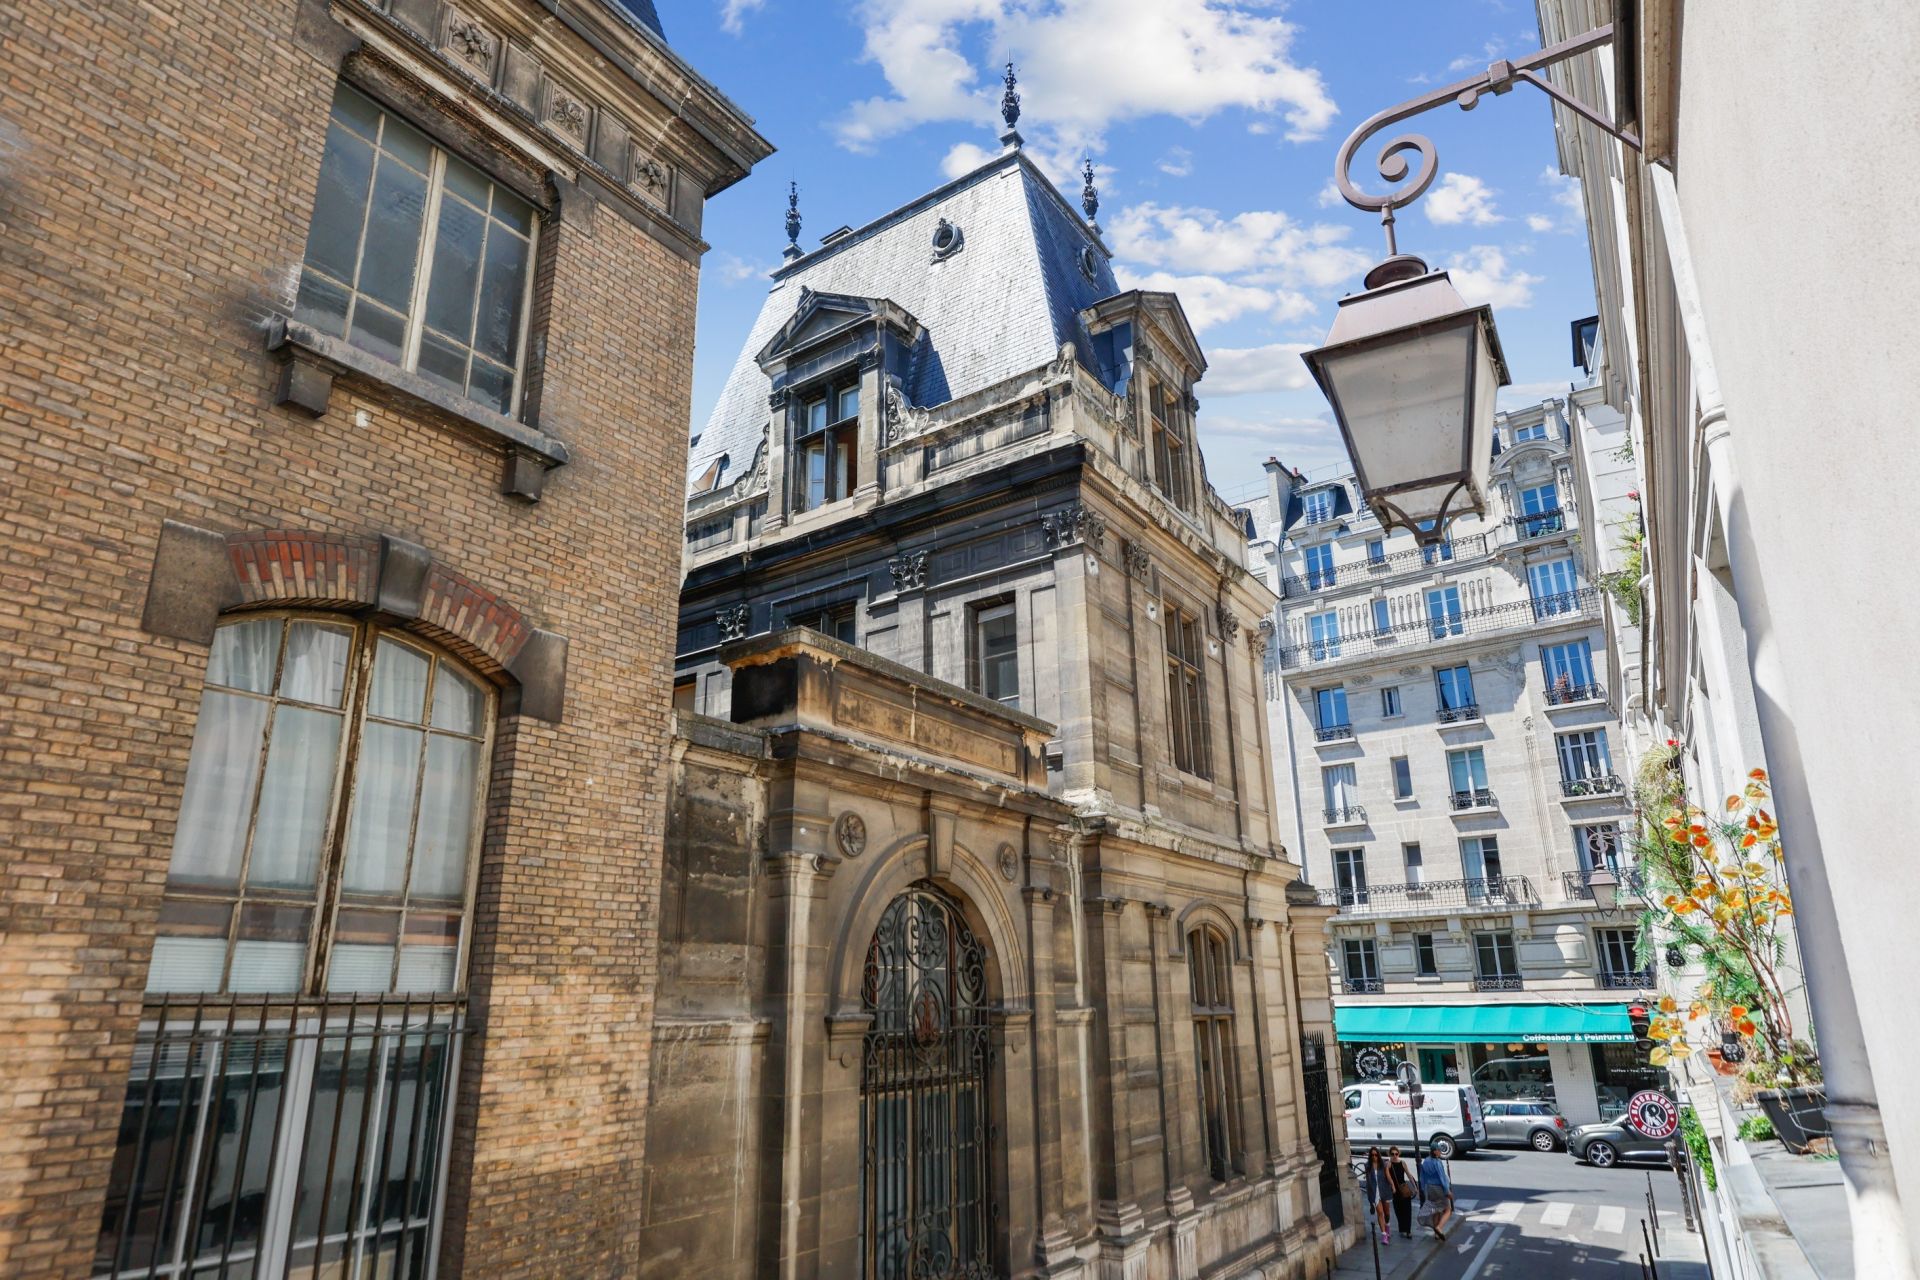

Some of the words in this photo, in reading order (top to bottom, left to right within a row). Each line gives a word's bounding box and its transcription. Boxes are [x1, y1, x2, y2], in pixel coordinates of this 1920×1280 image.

[1584, 1034, 1621, 1042] Peinture
[1631, 1093, 1675, 1115] BLACKWOOD
[1641, 1124, 1672, 1136] BEAUTY
